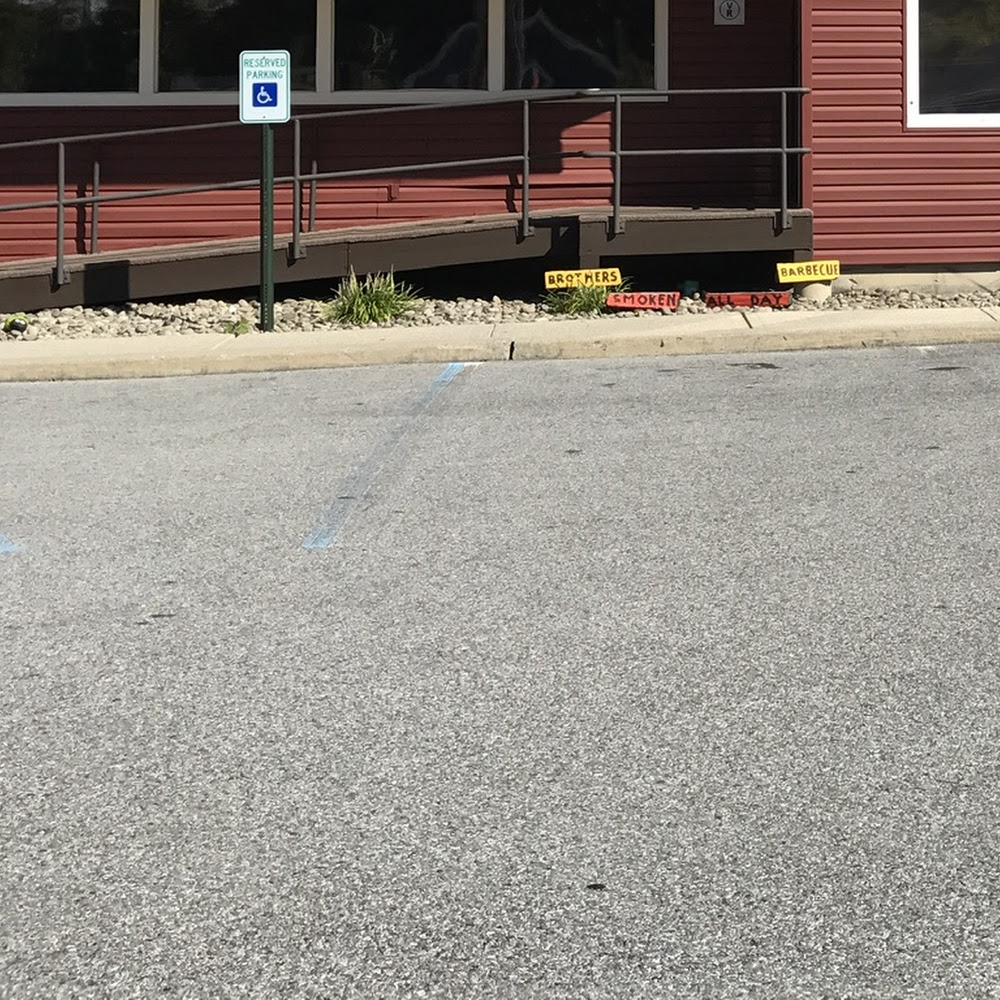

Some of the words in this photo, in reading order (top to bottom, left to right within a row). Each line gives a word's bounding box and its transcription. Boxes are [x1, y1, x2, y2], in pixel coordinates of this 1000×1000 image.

[243, 58, 286, 68] RESERVED
[246, 70, 283, 79] PARKING
[780, 264, 839, 277] BARBECUE
[547, 271, 618, 285] BROTHERS
[613, 294, 677, 307] SMOKEN
[706, 296, 735, 307] ALL
[749, 294, 783, 307] DAY
